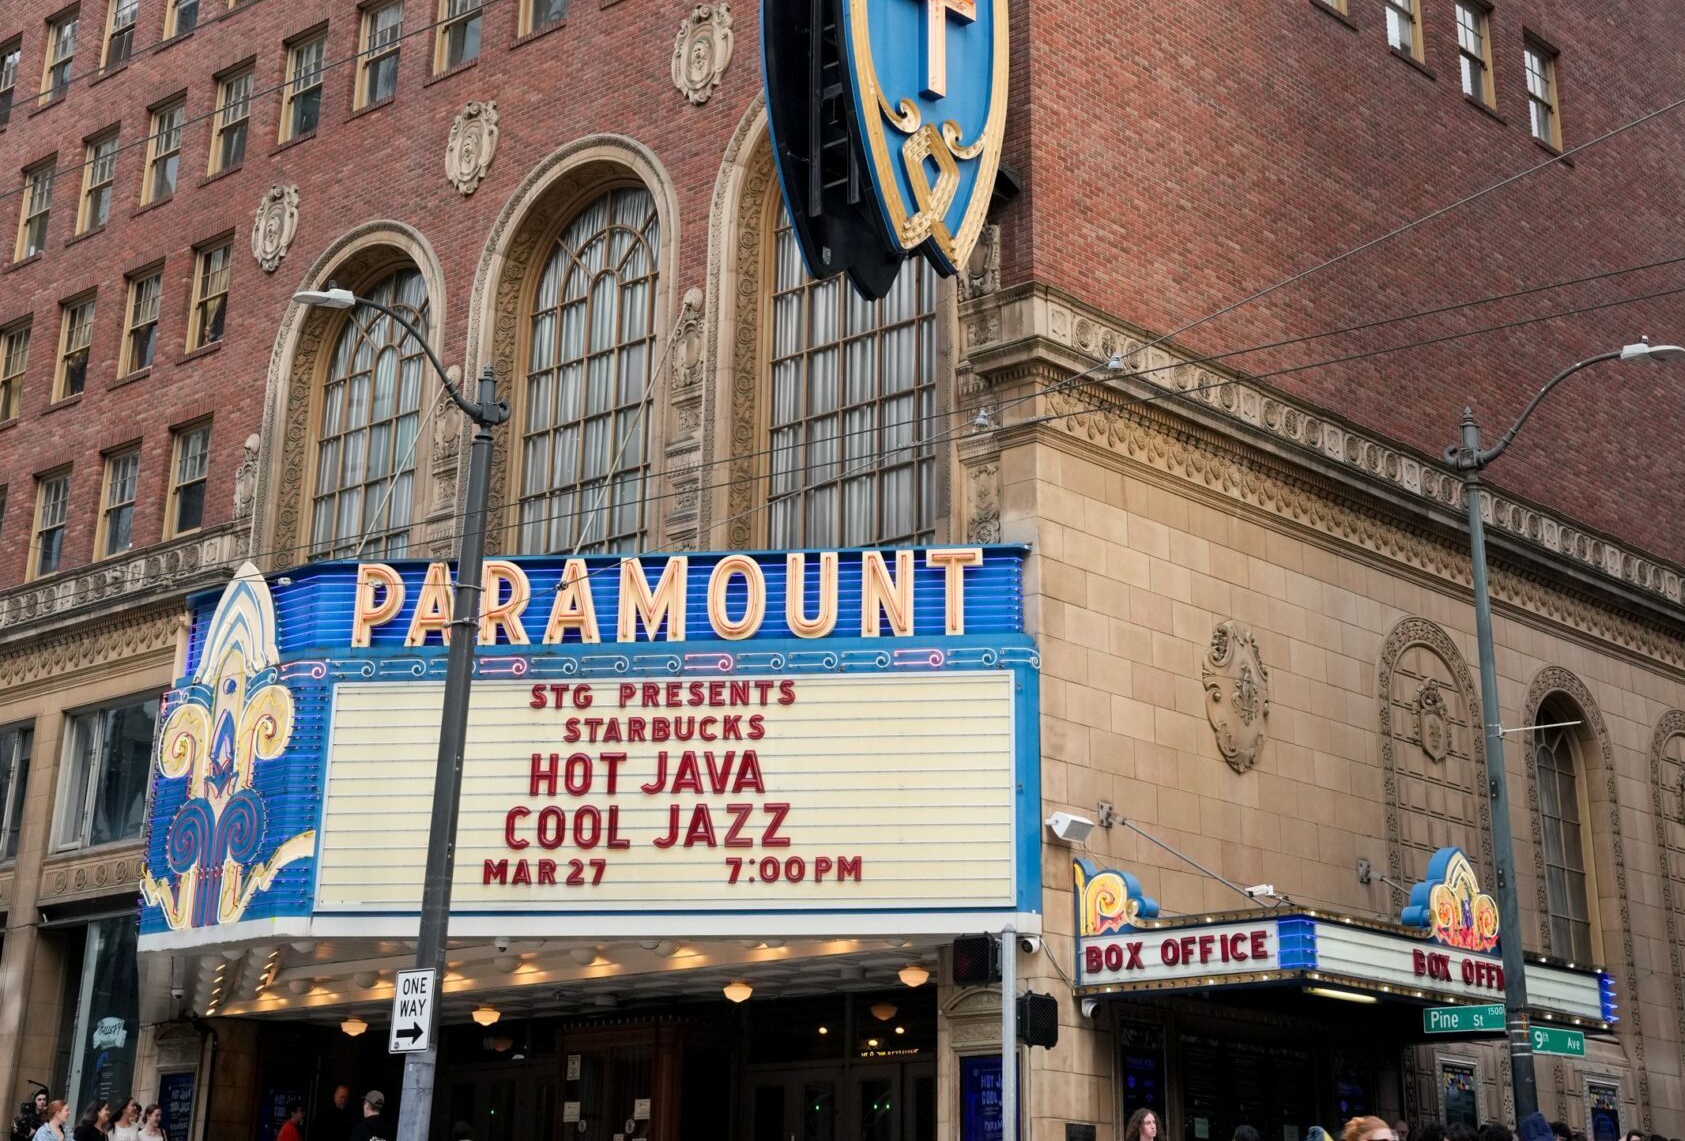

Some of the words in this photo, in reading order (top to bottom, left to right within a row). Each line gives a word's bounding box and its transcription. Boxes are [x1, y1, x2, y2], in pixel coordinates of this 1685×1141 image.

[351, 547, 984, 648] PARAMOUNT
[530, 683, 593, 710] STG
[618, 679, 797, 709] PRESENTS
[564, 713, 766, 743] STARBUCKS
[528, 751, 628, 798] HOT
[640, 749, 765, 796] JAVA
[503, 804, 630, 852] COOL
[652, 802, 791, 851] JAZZ
[1085, 942, 1144, 974] BOX
[1160, 930, 1268, 967] OFFICE
[1413, 948, 1453, 982] BOX
[1461, 958, 1505, 991] OFFI
[402, 977, 428, 995] ONE
[400, 998, 427, 1018] WAY
[1430, 1010, 1459, 1029] Pine
[1473, 1013, 1484, 1027] St
[1487, 1006, 1504, 1016] 1500
[1534, 1030, 1549, 1049] 9th
[1567, 1036, 1581, 1050] Ave
